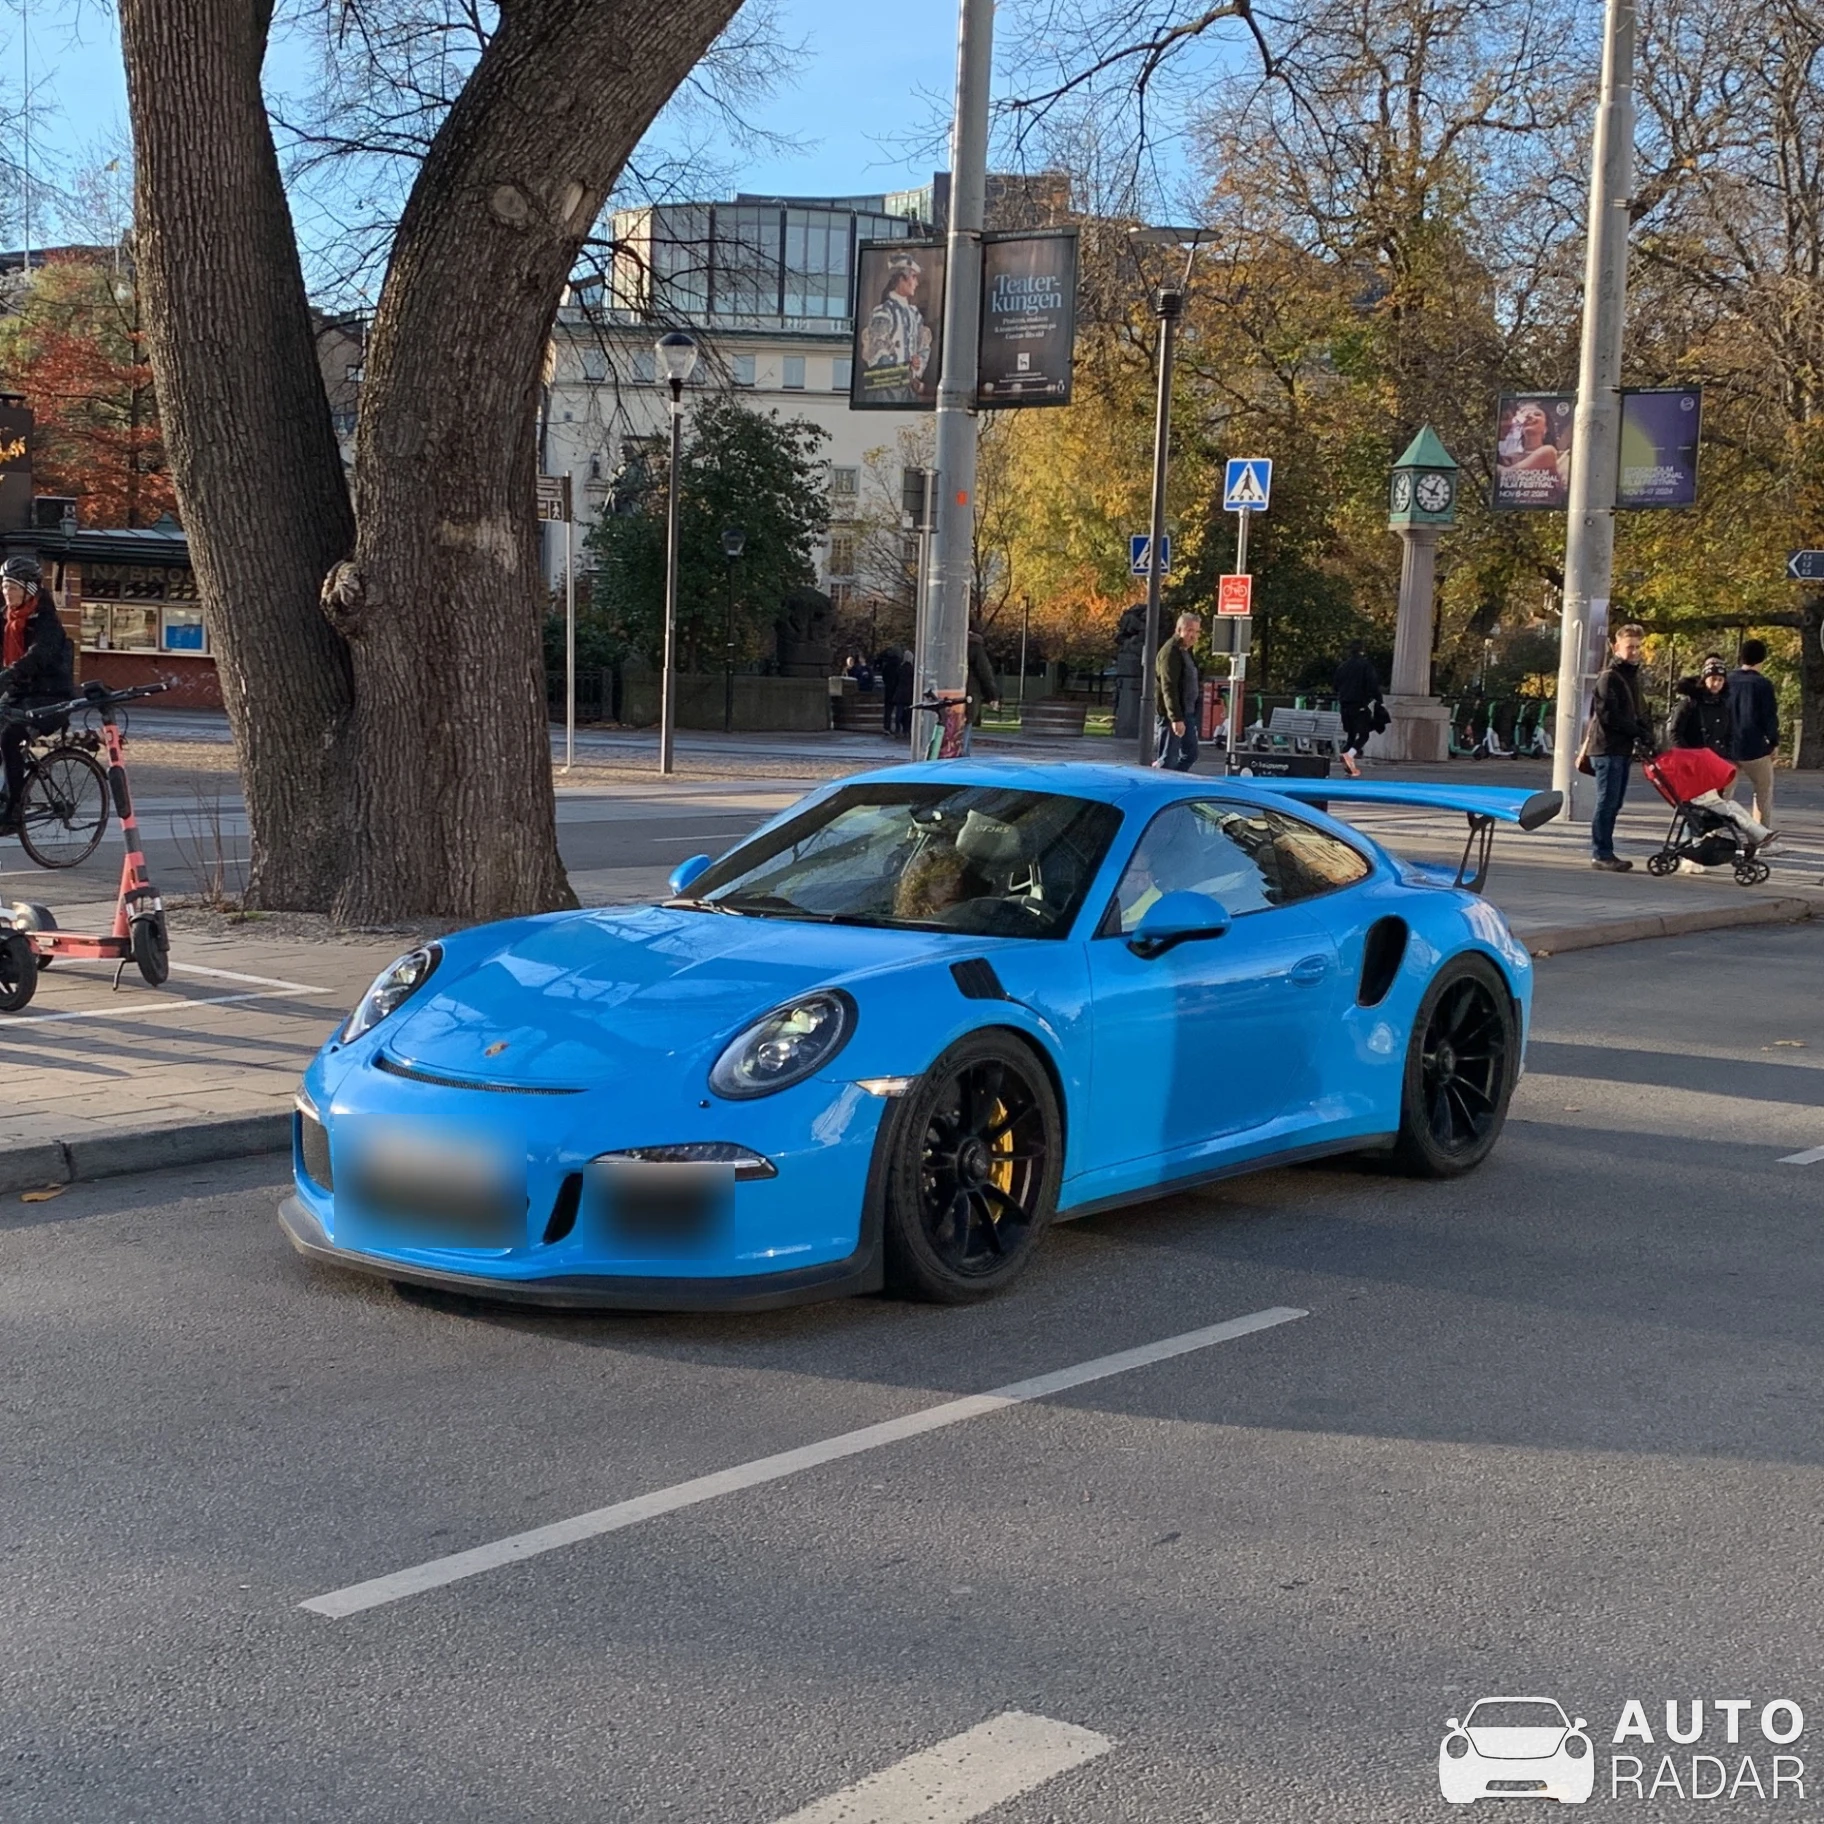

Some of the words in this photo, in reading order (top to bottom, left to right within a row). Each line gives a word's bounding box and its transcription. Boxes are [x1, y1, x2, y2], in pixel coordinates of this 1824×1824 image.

[994, 274, 1061, 295] Teater-
[992, 290, 1062, 316] kungen
[1500, 474, 1559, 482] INTERNATIONAL
[1500, 480, 1518, 488] FILM
[1622, 488, 1639, 496] NOV
